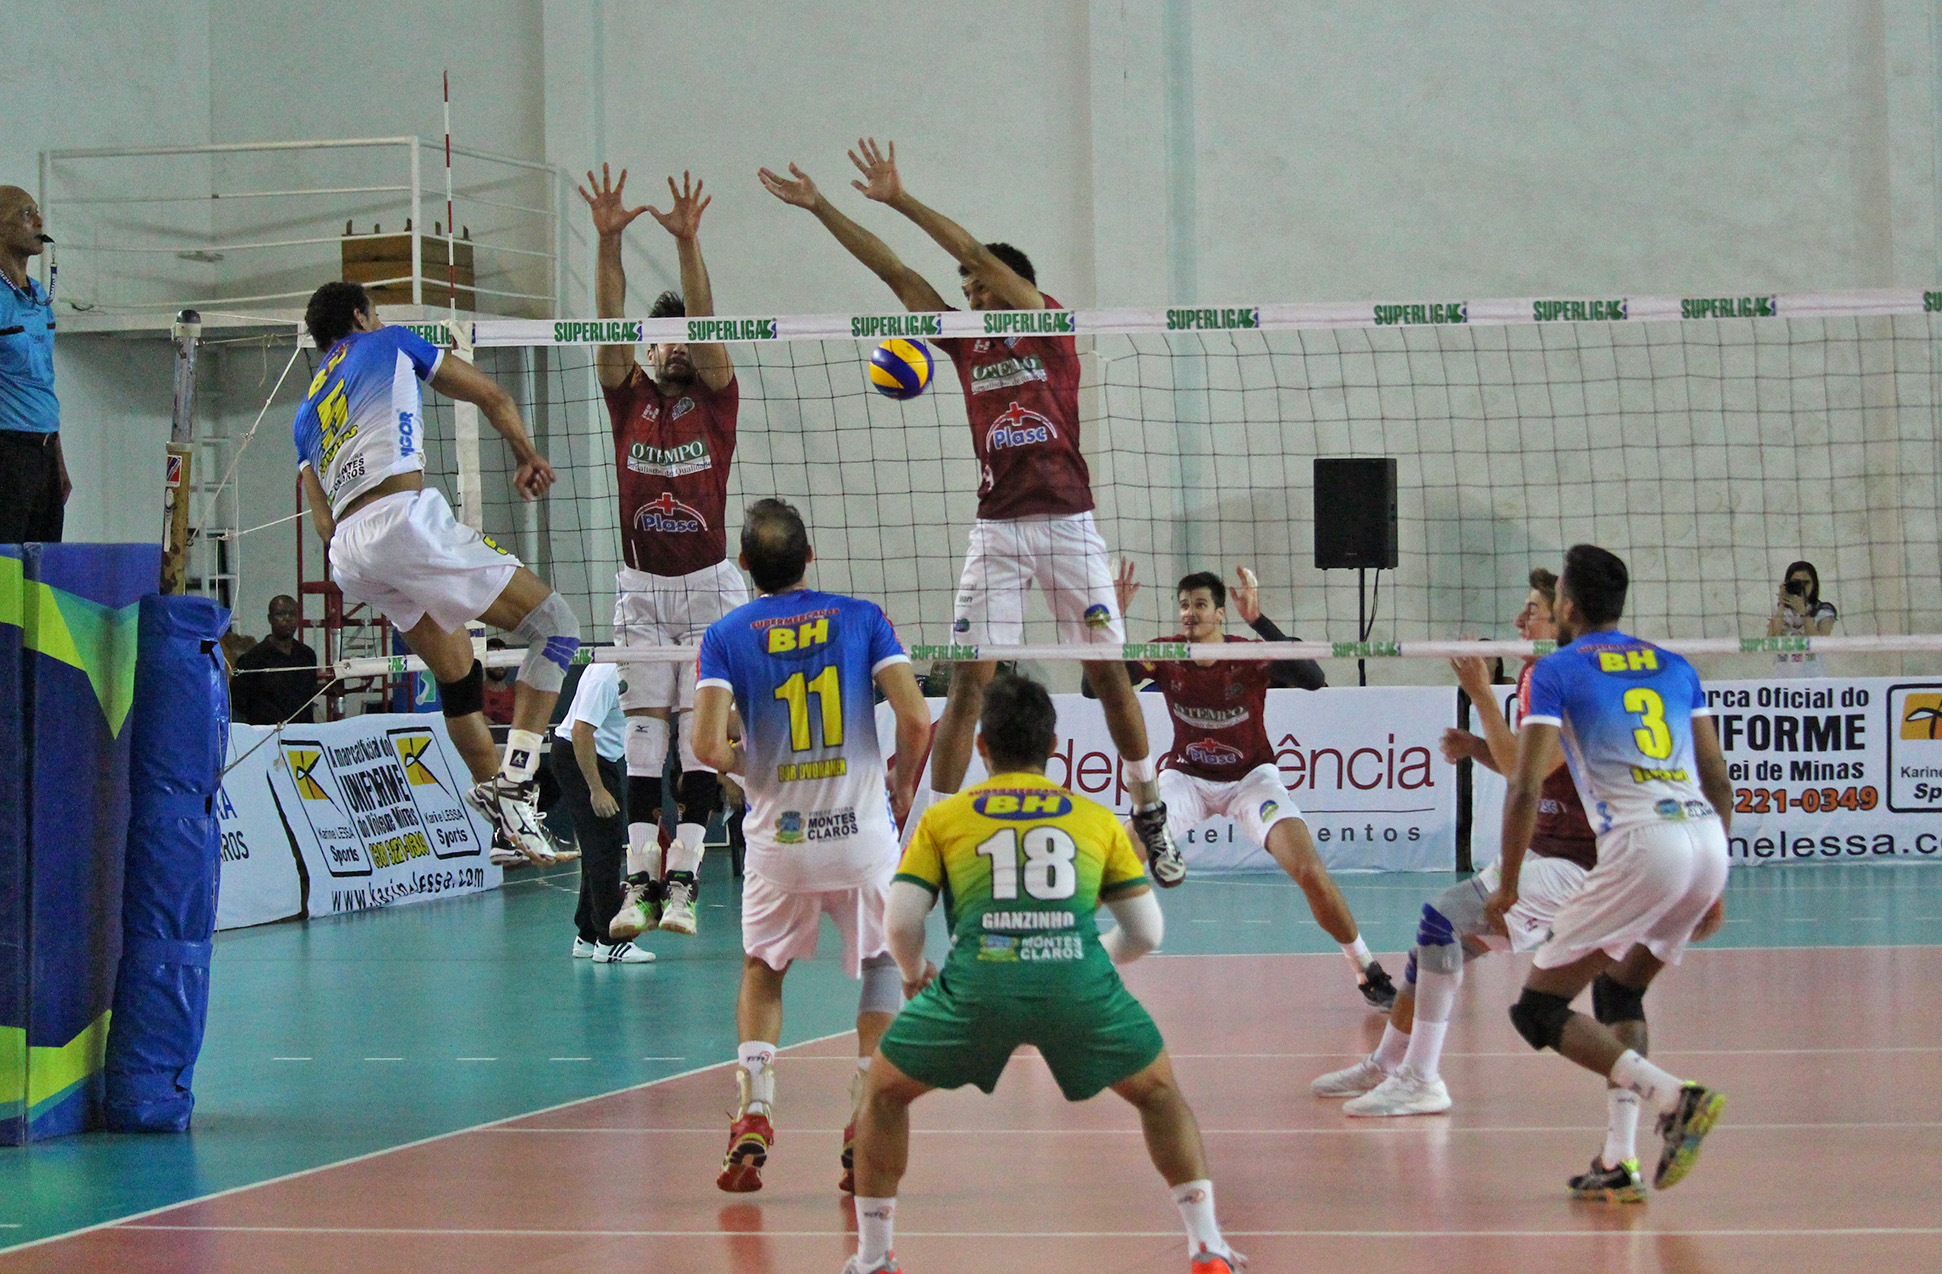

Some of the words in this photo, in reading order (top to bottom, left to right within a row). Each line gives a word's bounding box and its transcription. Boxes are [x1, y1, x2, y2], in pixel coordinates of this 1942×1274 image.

[1373, 303, 1453, 325] SUPERLIGA
[1533, 299, 1616, 321] SUPERLIGA
[1681, 298, 1764, 319] SUPERLIGA
[688, 320, 766, 340] SUPERLIGA
[851, 316, 931, 337] SUPERLIGA
[983, 312, 1063, 333] SUPERLIGA
[1166, 309, 1247, 330] SUPERLIGA
[554, 321, 631, 342] SUPERLIGA
[993, 427, 1048, 450] Plasc
[642, 513, 699, 532] Plasc
[767, 619, 829, 653] BH
[1597, 649, 1659, 672] BH
[1705, 690, 1750, 708] rca
[1758, 687, 1833, 708] Oficial
[1841, 687, 1869, 708] do
[774, 665, 845, 752] 11
[1623, 687, 1674, 761] 3
[1711, 714, 1865, 752] FORME
[1190, 747, 1237, 765] Plasc
[1756, 760, 1783, 780] de
[1790, 760, 1865, 781] Minas
[983, 795, 1061, 814] BH
[1732, 786, 1878, 813] 221-0349
[808, 812, 856, 829] MONTES
[808, 823, 859, 840] CLAROS
[329, 845, 360, 866] Sports
[975, 825, 1077, 900] 18
[982, 911, 1075, 930] GIANZINHO
[1021, 935, 1083, 949] MONTES
[1020, 947, 1084, 960] CLAROS
